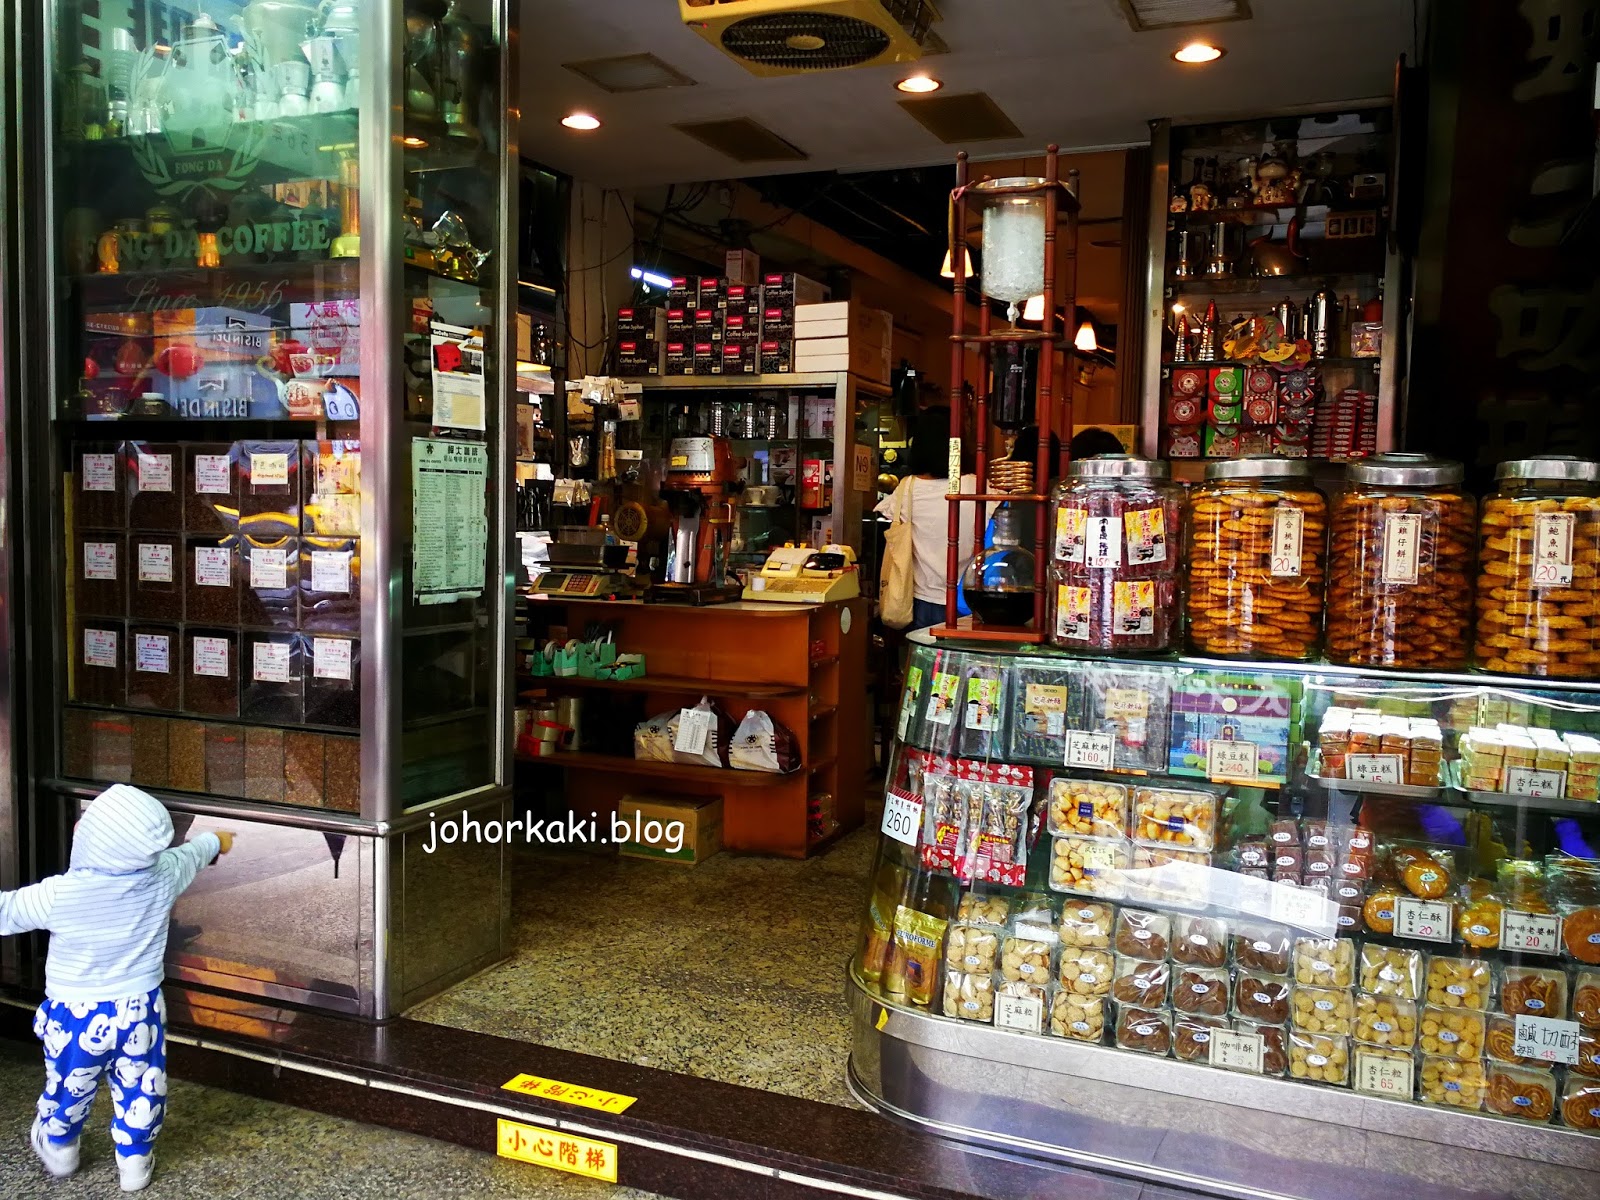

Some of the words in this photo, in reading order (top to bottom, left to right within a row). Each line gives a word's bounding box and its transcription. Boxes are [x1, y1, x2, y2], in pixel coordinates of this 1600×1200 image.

[207, 158, 223, 172] DA
[81, 230, 157, 260] FNG
[215, 219, 331, 255] COFFEE
[219, 278, 289, 312] 1956
[1274, 557, 1290, 572] 20
[1536, 565, 1557, 580] 20
[1072, 740, 1109, 751] 芝麻軟糖
[1083, 751, 1099, 763] 160
[1225, 763, 1243, 773] 240
[886, 809, 911, 835] 260
[1406, 909, 1442, 922] 杏仁酥
[1419, 925, 1433, 935] 20
[1526, 936, 1540, 947] 20
[1368, 1065, 1402, 1078] 杏仁粒
[1381, 1078, 1393, 1089] 65
[520, 1080, 618, 1106] 小心階梯
[508, 1129, 606, 1171] 小心階梯
